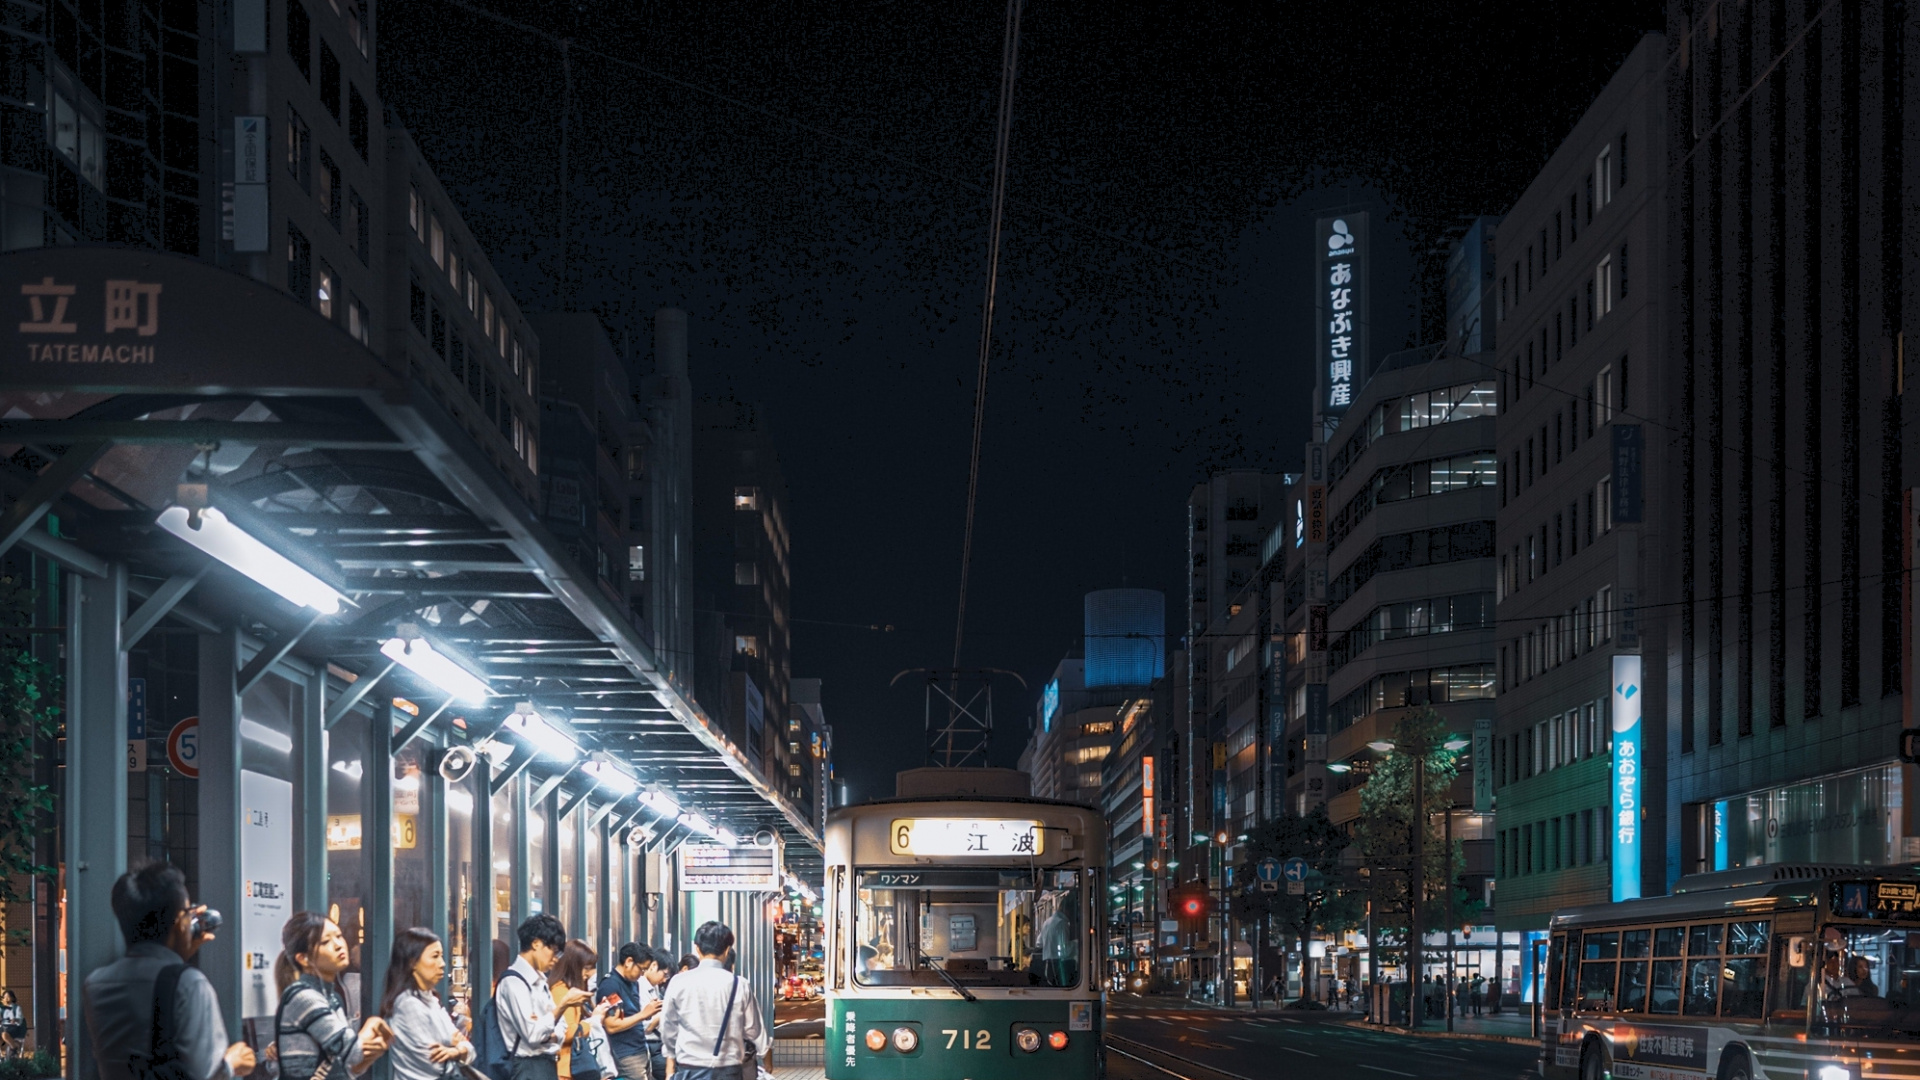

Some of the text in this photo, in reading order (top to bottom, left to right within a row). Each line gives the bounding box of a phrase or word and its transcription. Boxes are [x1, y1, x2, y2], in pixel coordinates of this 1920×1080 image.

[19, 276, 163, 336] 立町
[1330, 263, 1352, 407] あなぶき興産
[28, 343, 155, 364] TATEMACHI
[1477, 735, 1489, 799] アイティオー
[1617, 740, 1637, 844] あおぞら銀行
[896, 824, 911, 849] 6
[967, 833, 1035, 854] 江波
[881, 874, 920, 886] ワンマン
[845, 1011, 857, 1067] 乗降者優先
[941, 1029, 992, 1050] 712
[1638, 1034, 1694, 1058] 住友不動産販売
